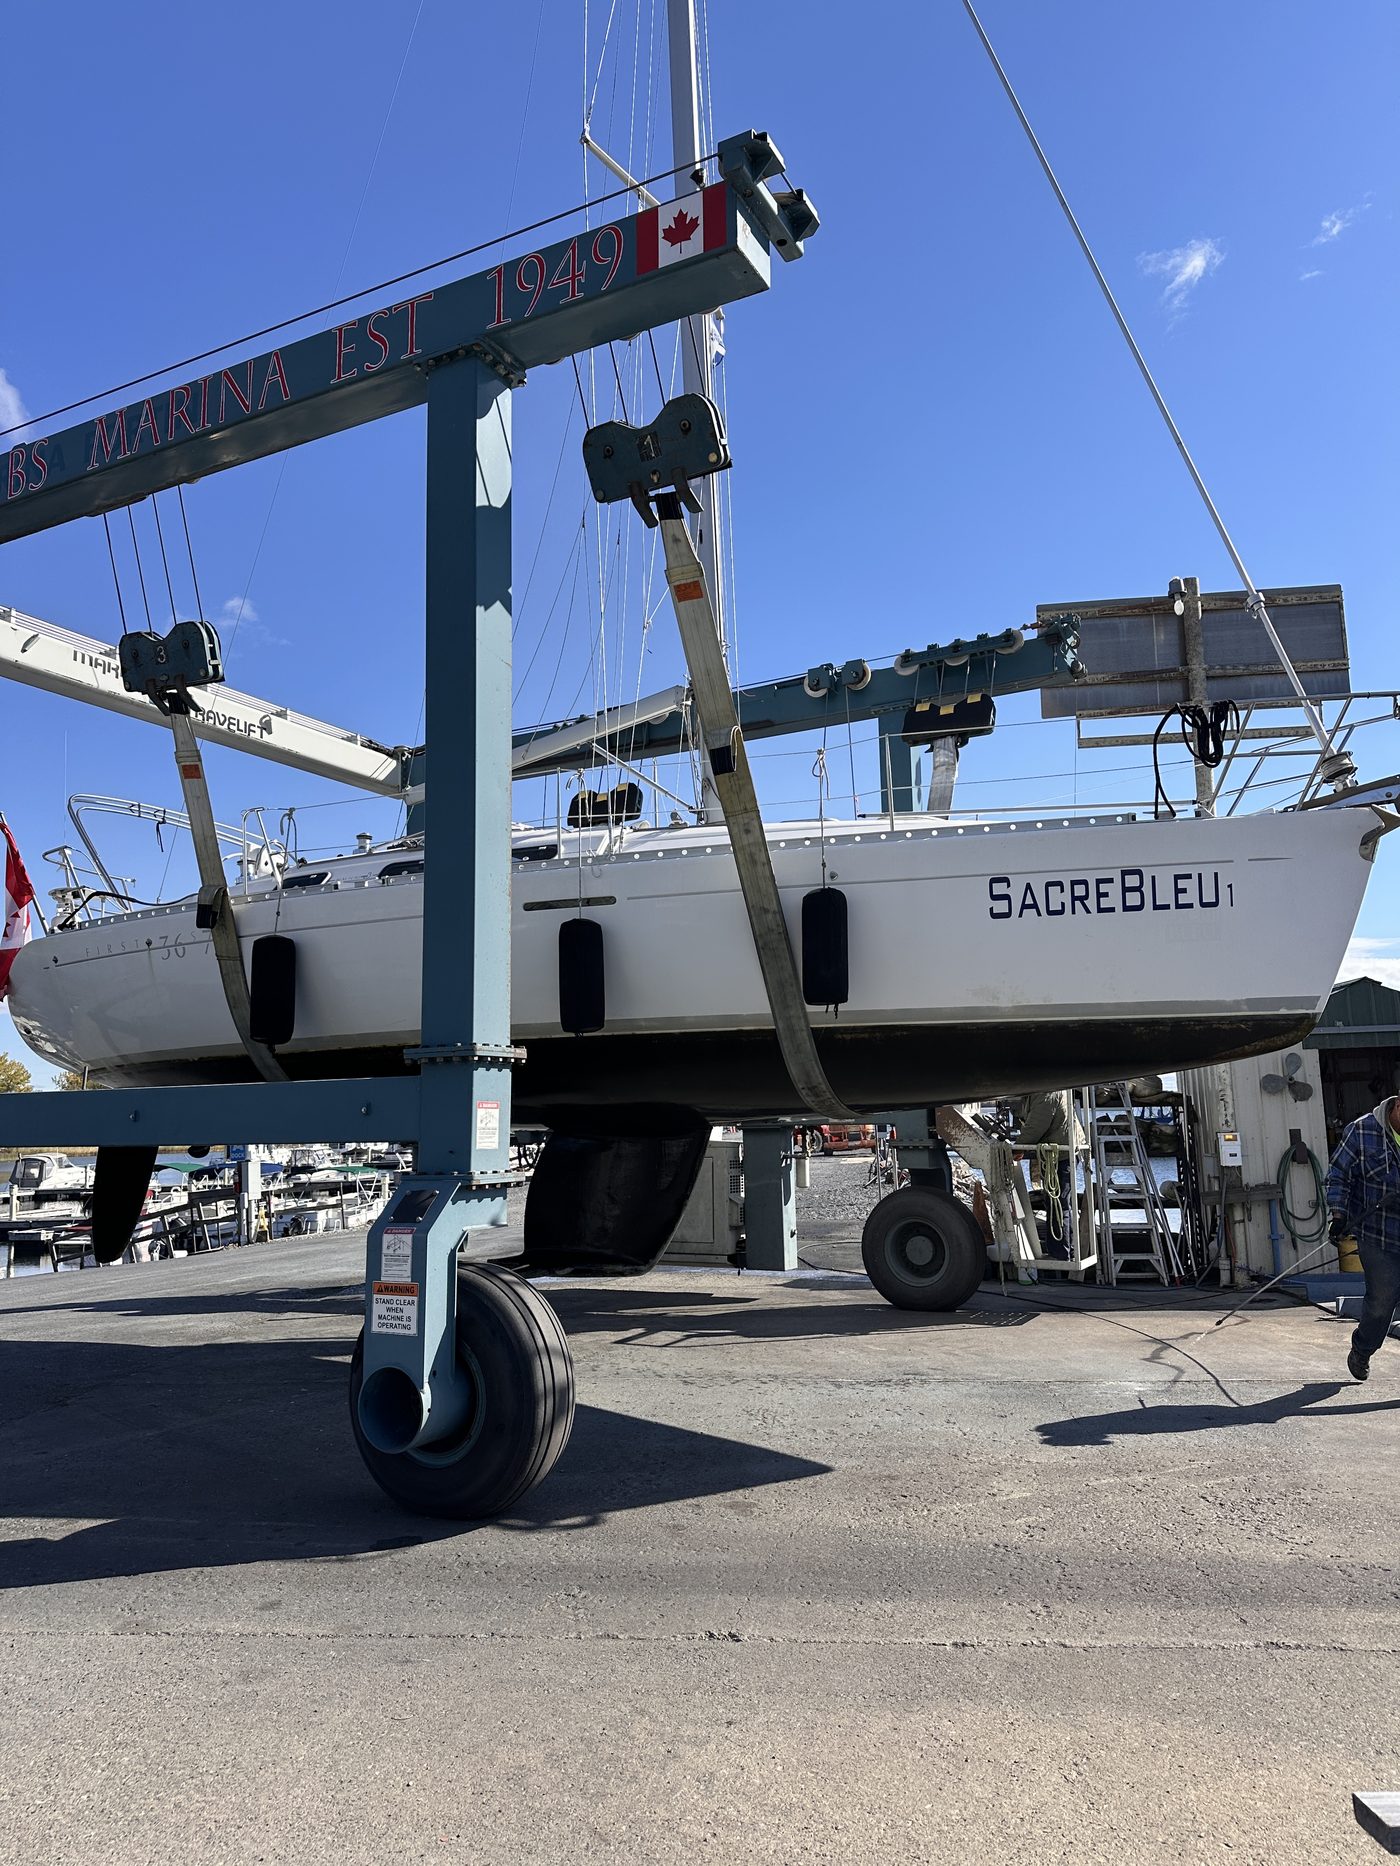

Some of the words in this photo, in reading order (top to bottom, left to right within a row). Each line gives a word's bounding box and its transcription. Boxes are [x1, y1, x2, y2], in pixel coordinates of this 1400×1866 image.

[87, 350, 291, 471] MARINA
[330, 293, 434, 384] EST
[486, 225, 624, 330] 1949
[156, 645, 167, 663] 3
[73, 649, 121, 680] MAR
[194, 707, 267, 739] RAVELIFT
[84, 938, 140, 957] FIRST
[383, 1284, 415, 1295] WARNING
[375, 1297, 394, 1306] STAND
[395, 1298, 415, 1307] CLEAR
[385, 1306, 404, 1314] WHEN
[377, 1314, 404, 1322] MACHINE
[405, 1315, 411, 1323] IS
[377, 1321, 411, 1331] OPERATING
